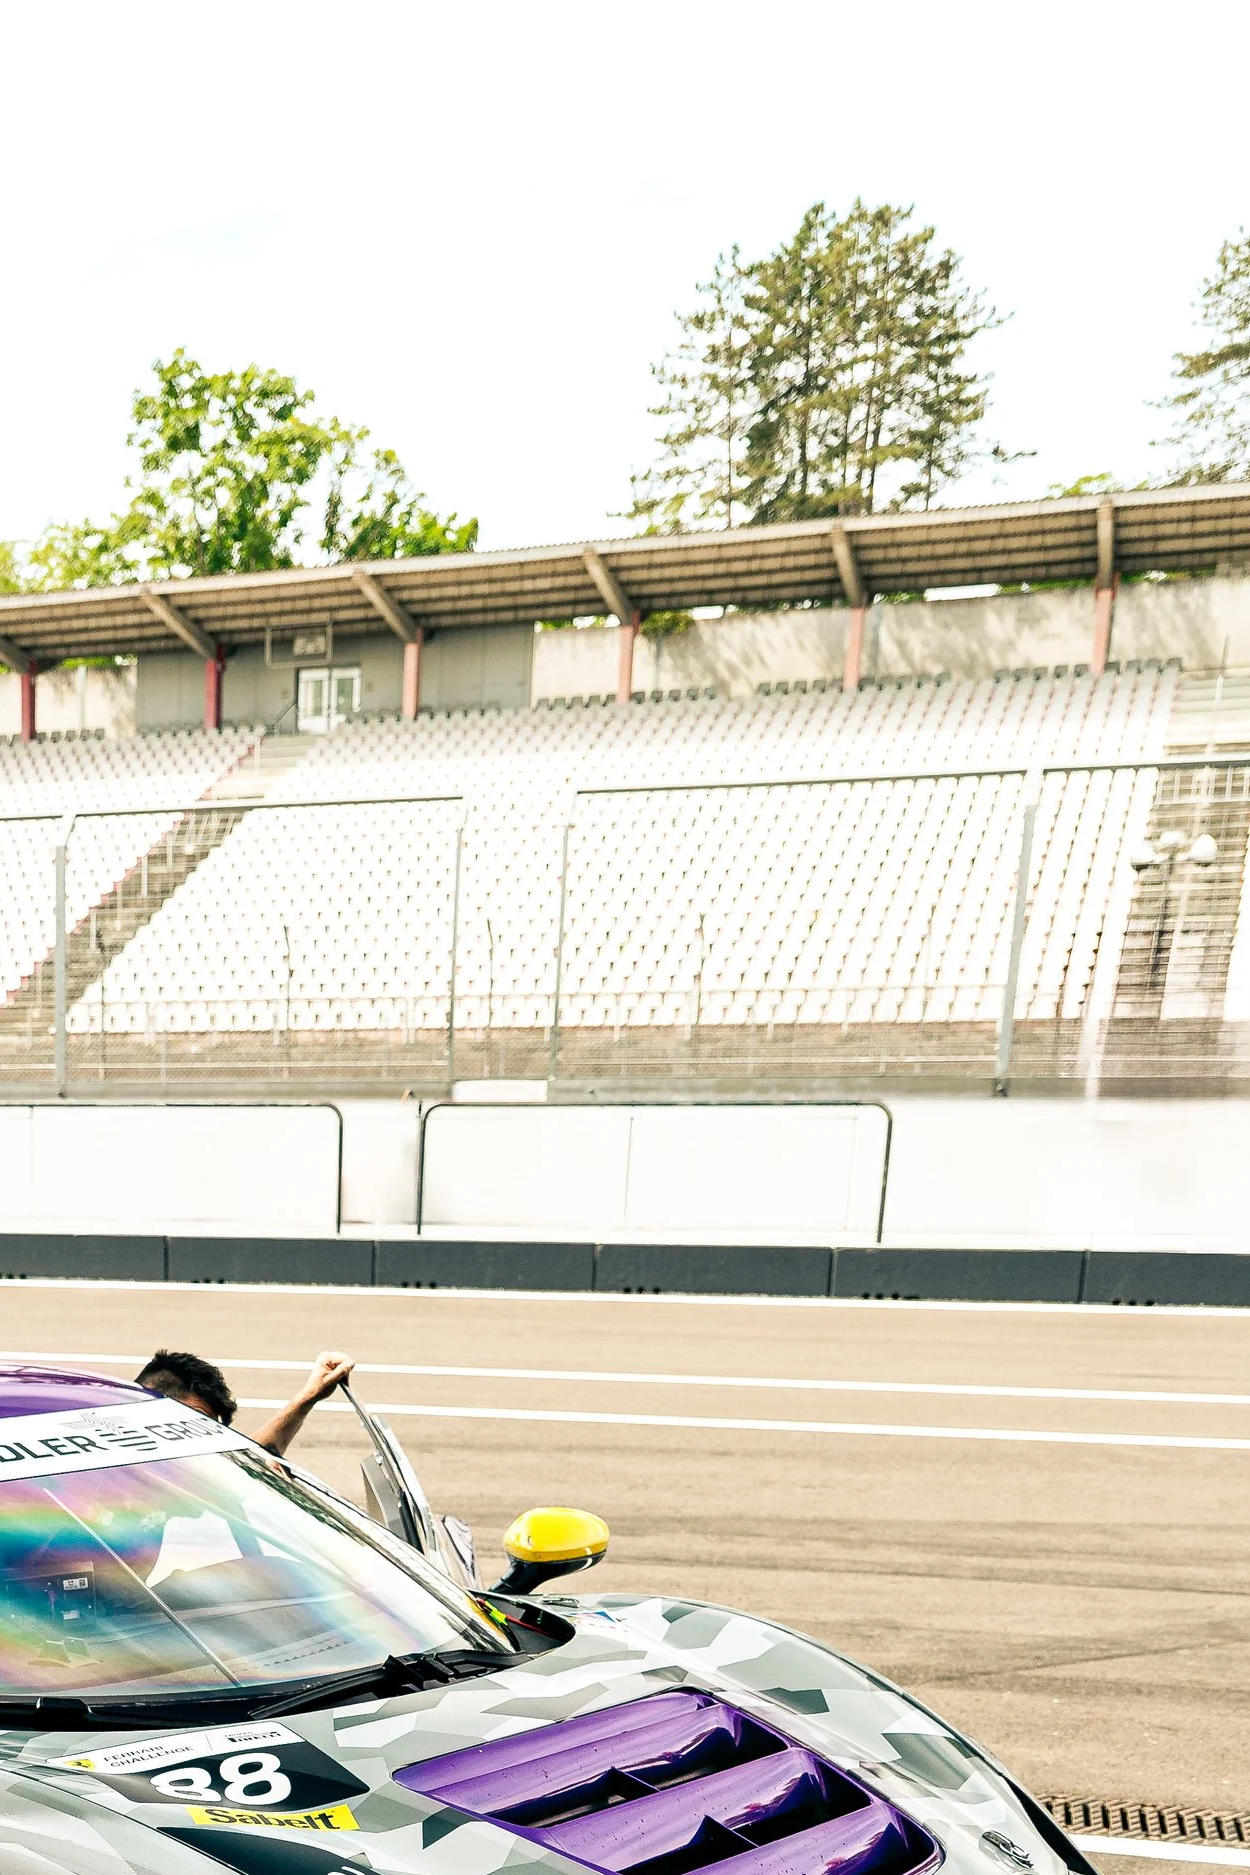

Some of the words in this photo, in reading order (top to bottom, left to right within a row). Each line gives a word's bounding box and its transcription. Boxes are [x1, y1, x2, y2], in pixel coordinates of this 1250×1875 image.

[103, 1745, 164, 1762] FERRARI
[110, 1746, 195, 1768] CHALLENGE
[150, 1752, 291, 1805] 88
[204, 1808, 341, 1830] Sabelt
